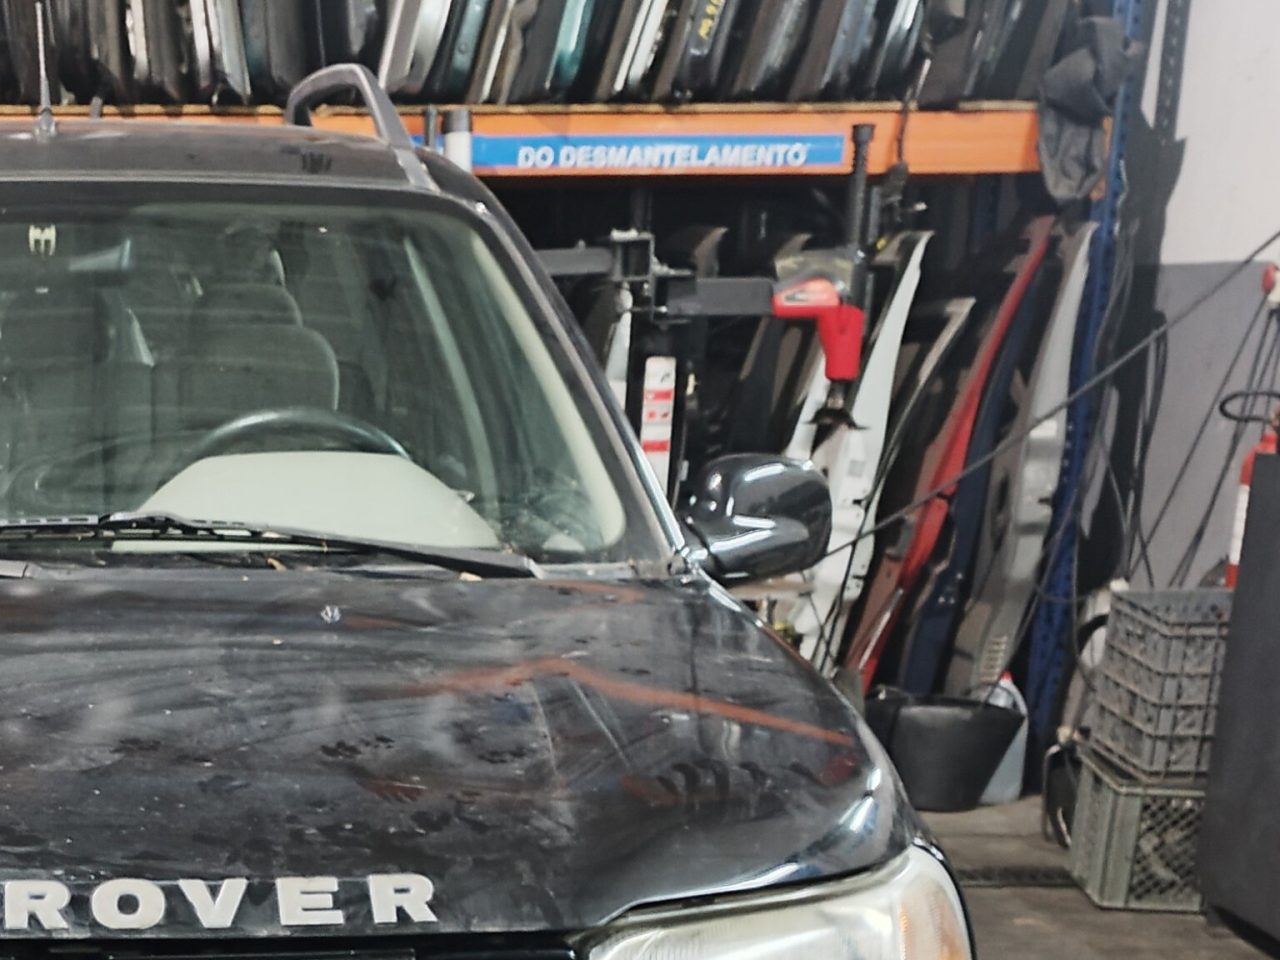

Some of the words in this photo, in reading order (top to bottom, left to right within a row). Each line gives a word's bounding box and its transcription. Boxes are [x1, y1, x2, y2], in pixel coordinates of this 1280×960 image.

[517, 144, 551, 168] DO
[558, 141, 808, 168] DESMANTELAMENTO
[4, 873, 439, 930] ROVER
